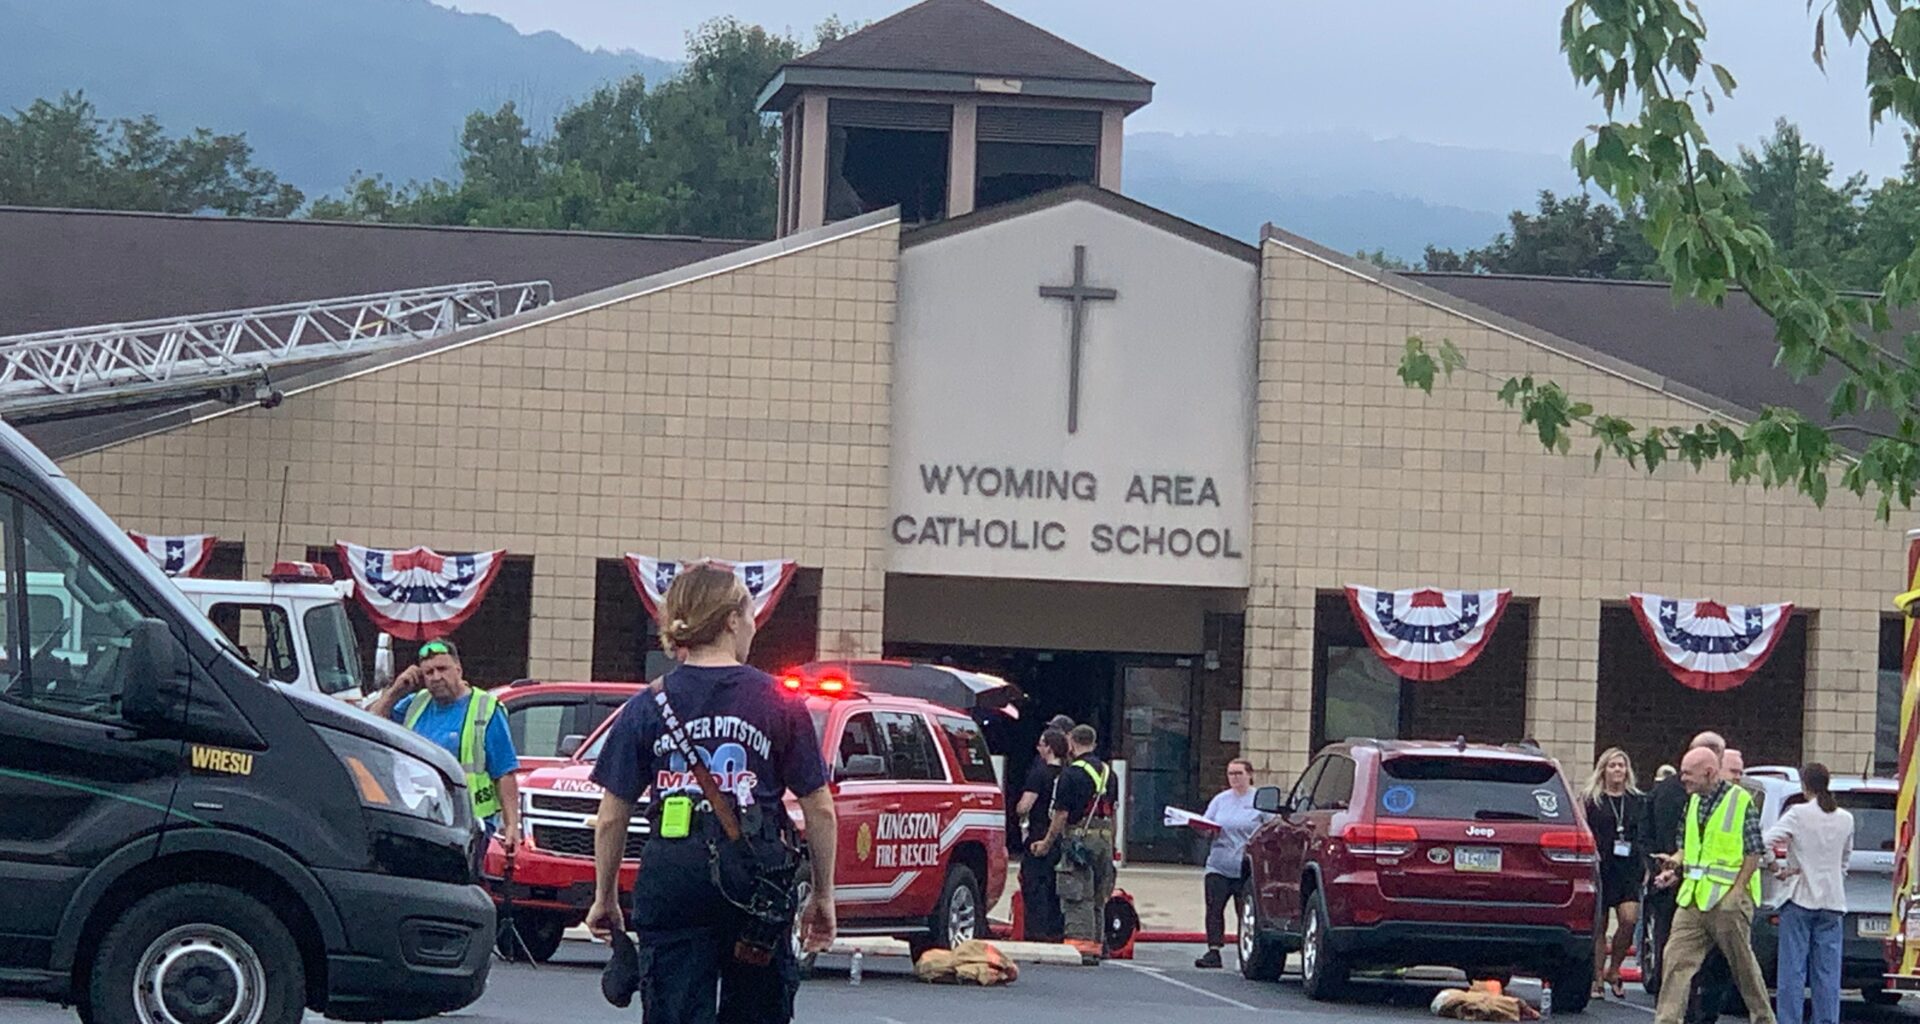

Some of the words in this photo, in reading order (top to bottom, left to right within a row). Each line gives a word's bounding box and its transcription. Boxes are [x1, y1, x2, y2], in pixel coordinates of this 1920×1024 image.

[919, 463, 1098, 502] WYOMING
[1124, 474, 1221, 507] AREA
[891, 514, 1067, 552] CATHOLIC
[1090, 523, 1242, 559] SCHOOL
[653, 717, 711, 757] GRETER
[714, 715, 772, 760] PITTSTON
[192, 745, 253, 775] WRESU
[551, 777, 606, 794] KINGS
[875, 812, 941, 840] KINGSTON
[1465, 825, 1496, 839] Jeep
[874, 844, 898, 868] FIRE
[899, 843, 940, 866] RESCUE
